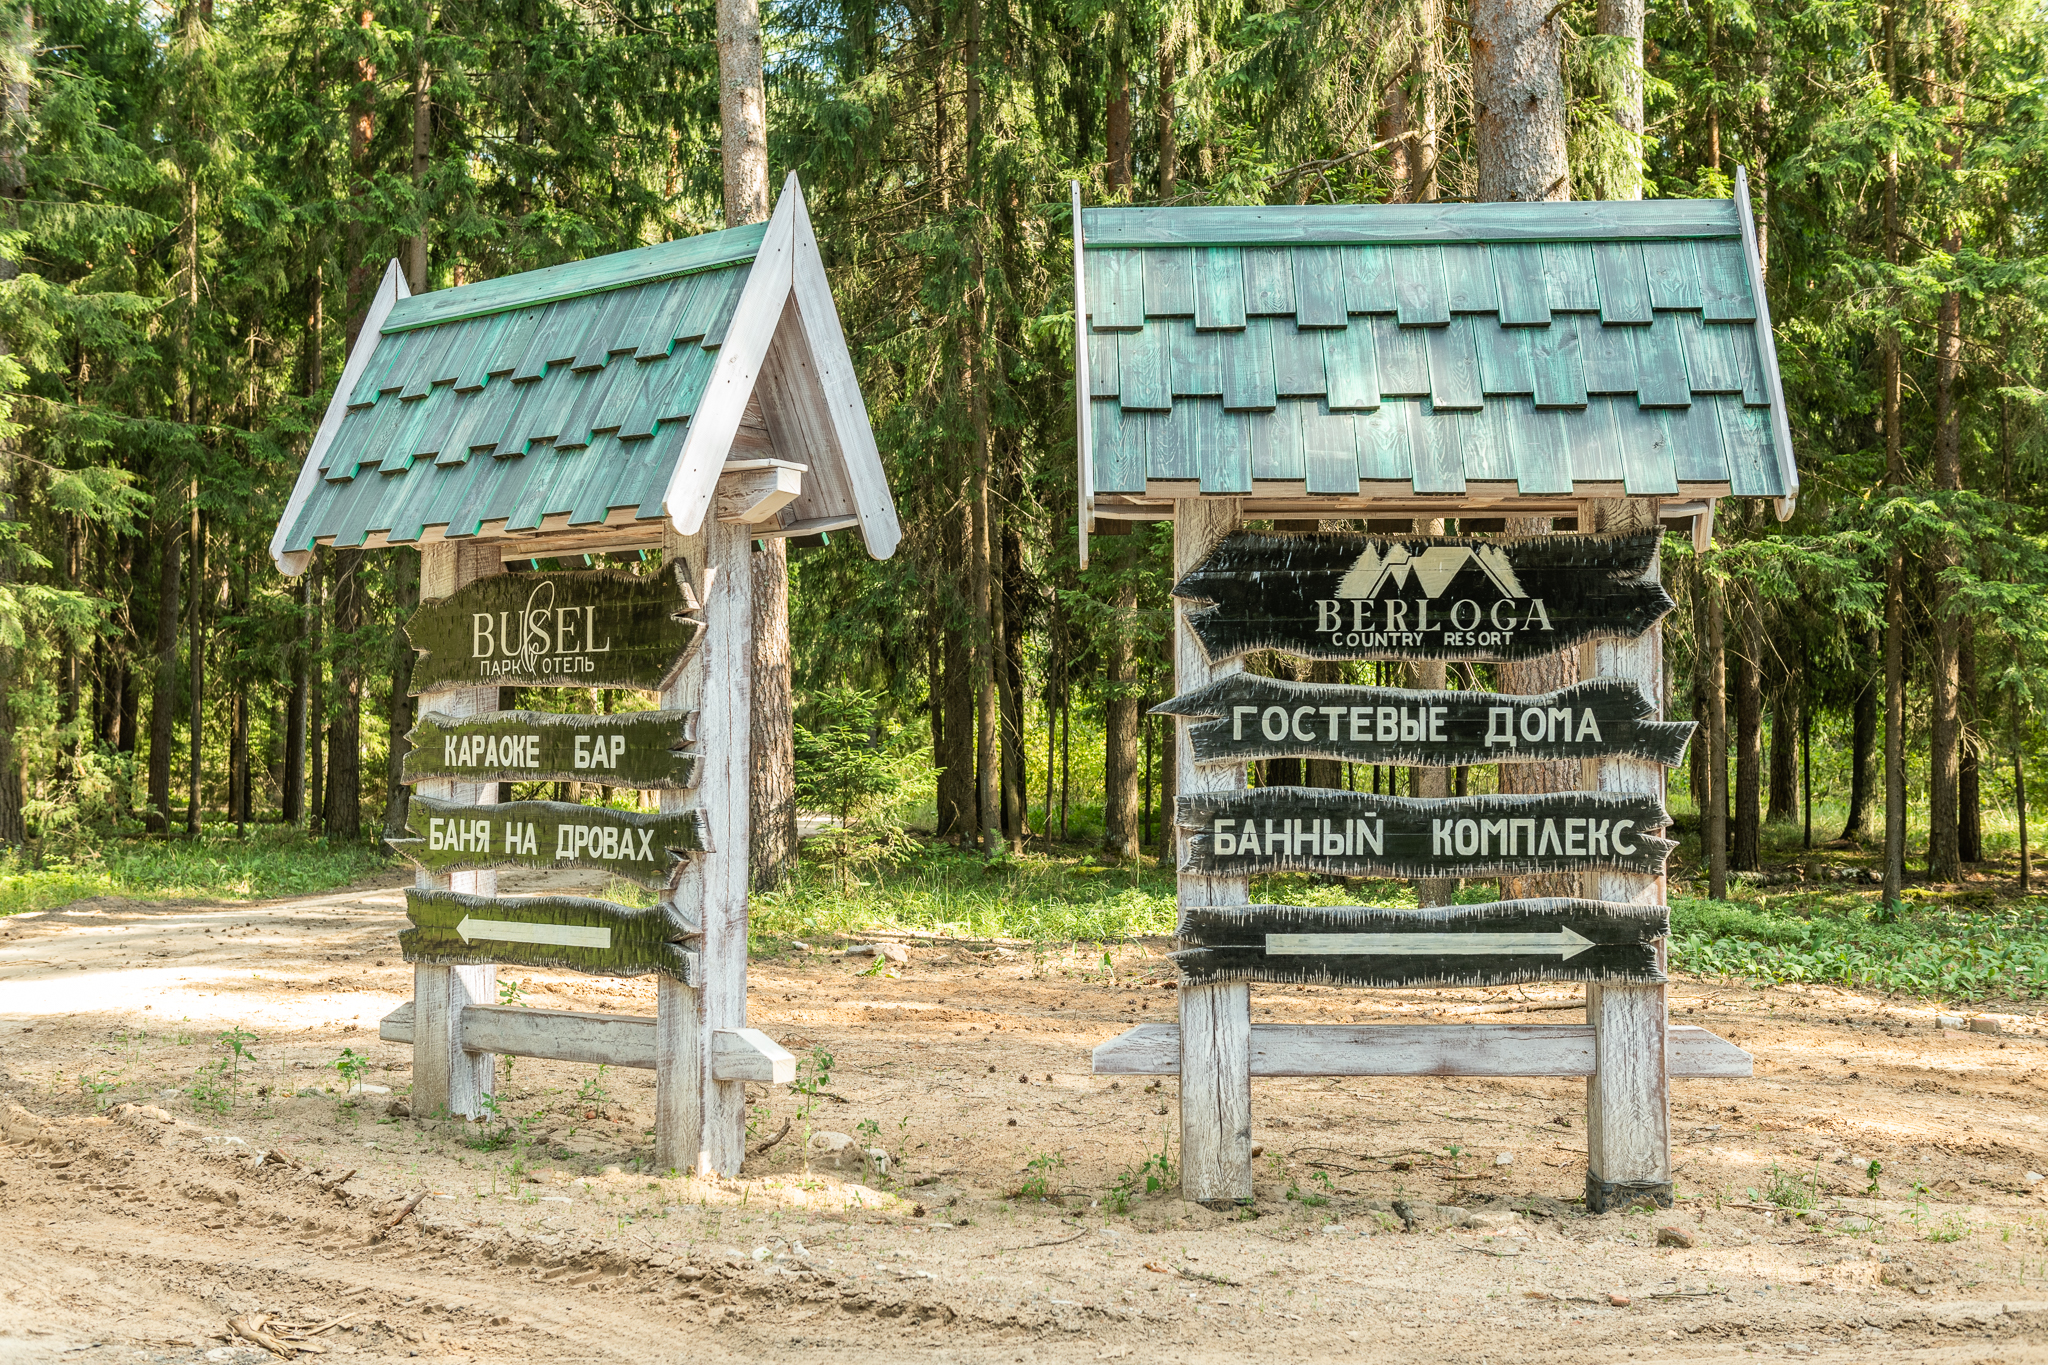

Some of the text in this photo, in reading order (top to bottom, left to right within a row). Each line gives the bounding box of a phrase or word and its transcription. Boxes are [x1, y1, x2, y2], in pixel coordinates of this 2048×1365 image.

[472, 605, 610, 659] BUSEL
[1315, 598, 1554, 632] BERLOGA
[1332, 631, 1514, 648] COUNTRY RESORT
[480, 656, 595, 676] ПАРК ОТЕЛЬ
[1233, 705, 1602, 747] ГОСТЕВЫЕ ДОМА
[444, 734, 626, 769] КАРАОКЕ БАР
[429, 817, 655, 862] БАНЯ НА ДРОВАХ
[1213, 811, 1638, 857] БАННЫЙ КОМПЛЕКС
